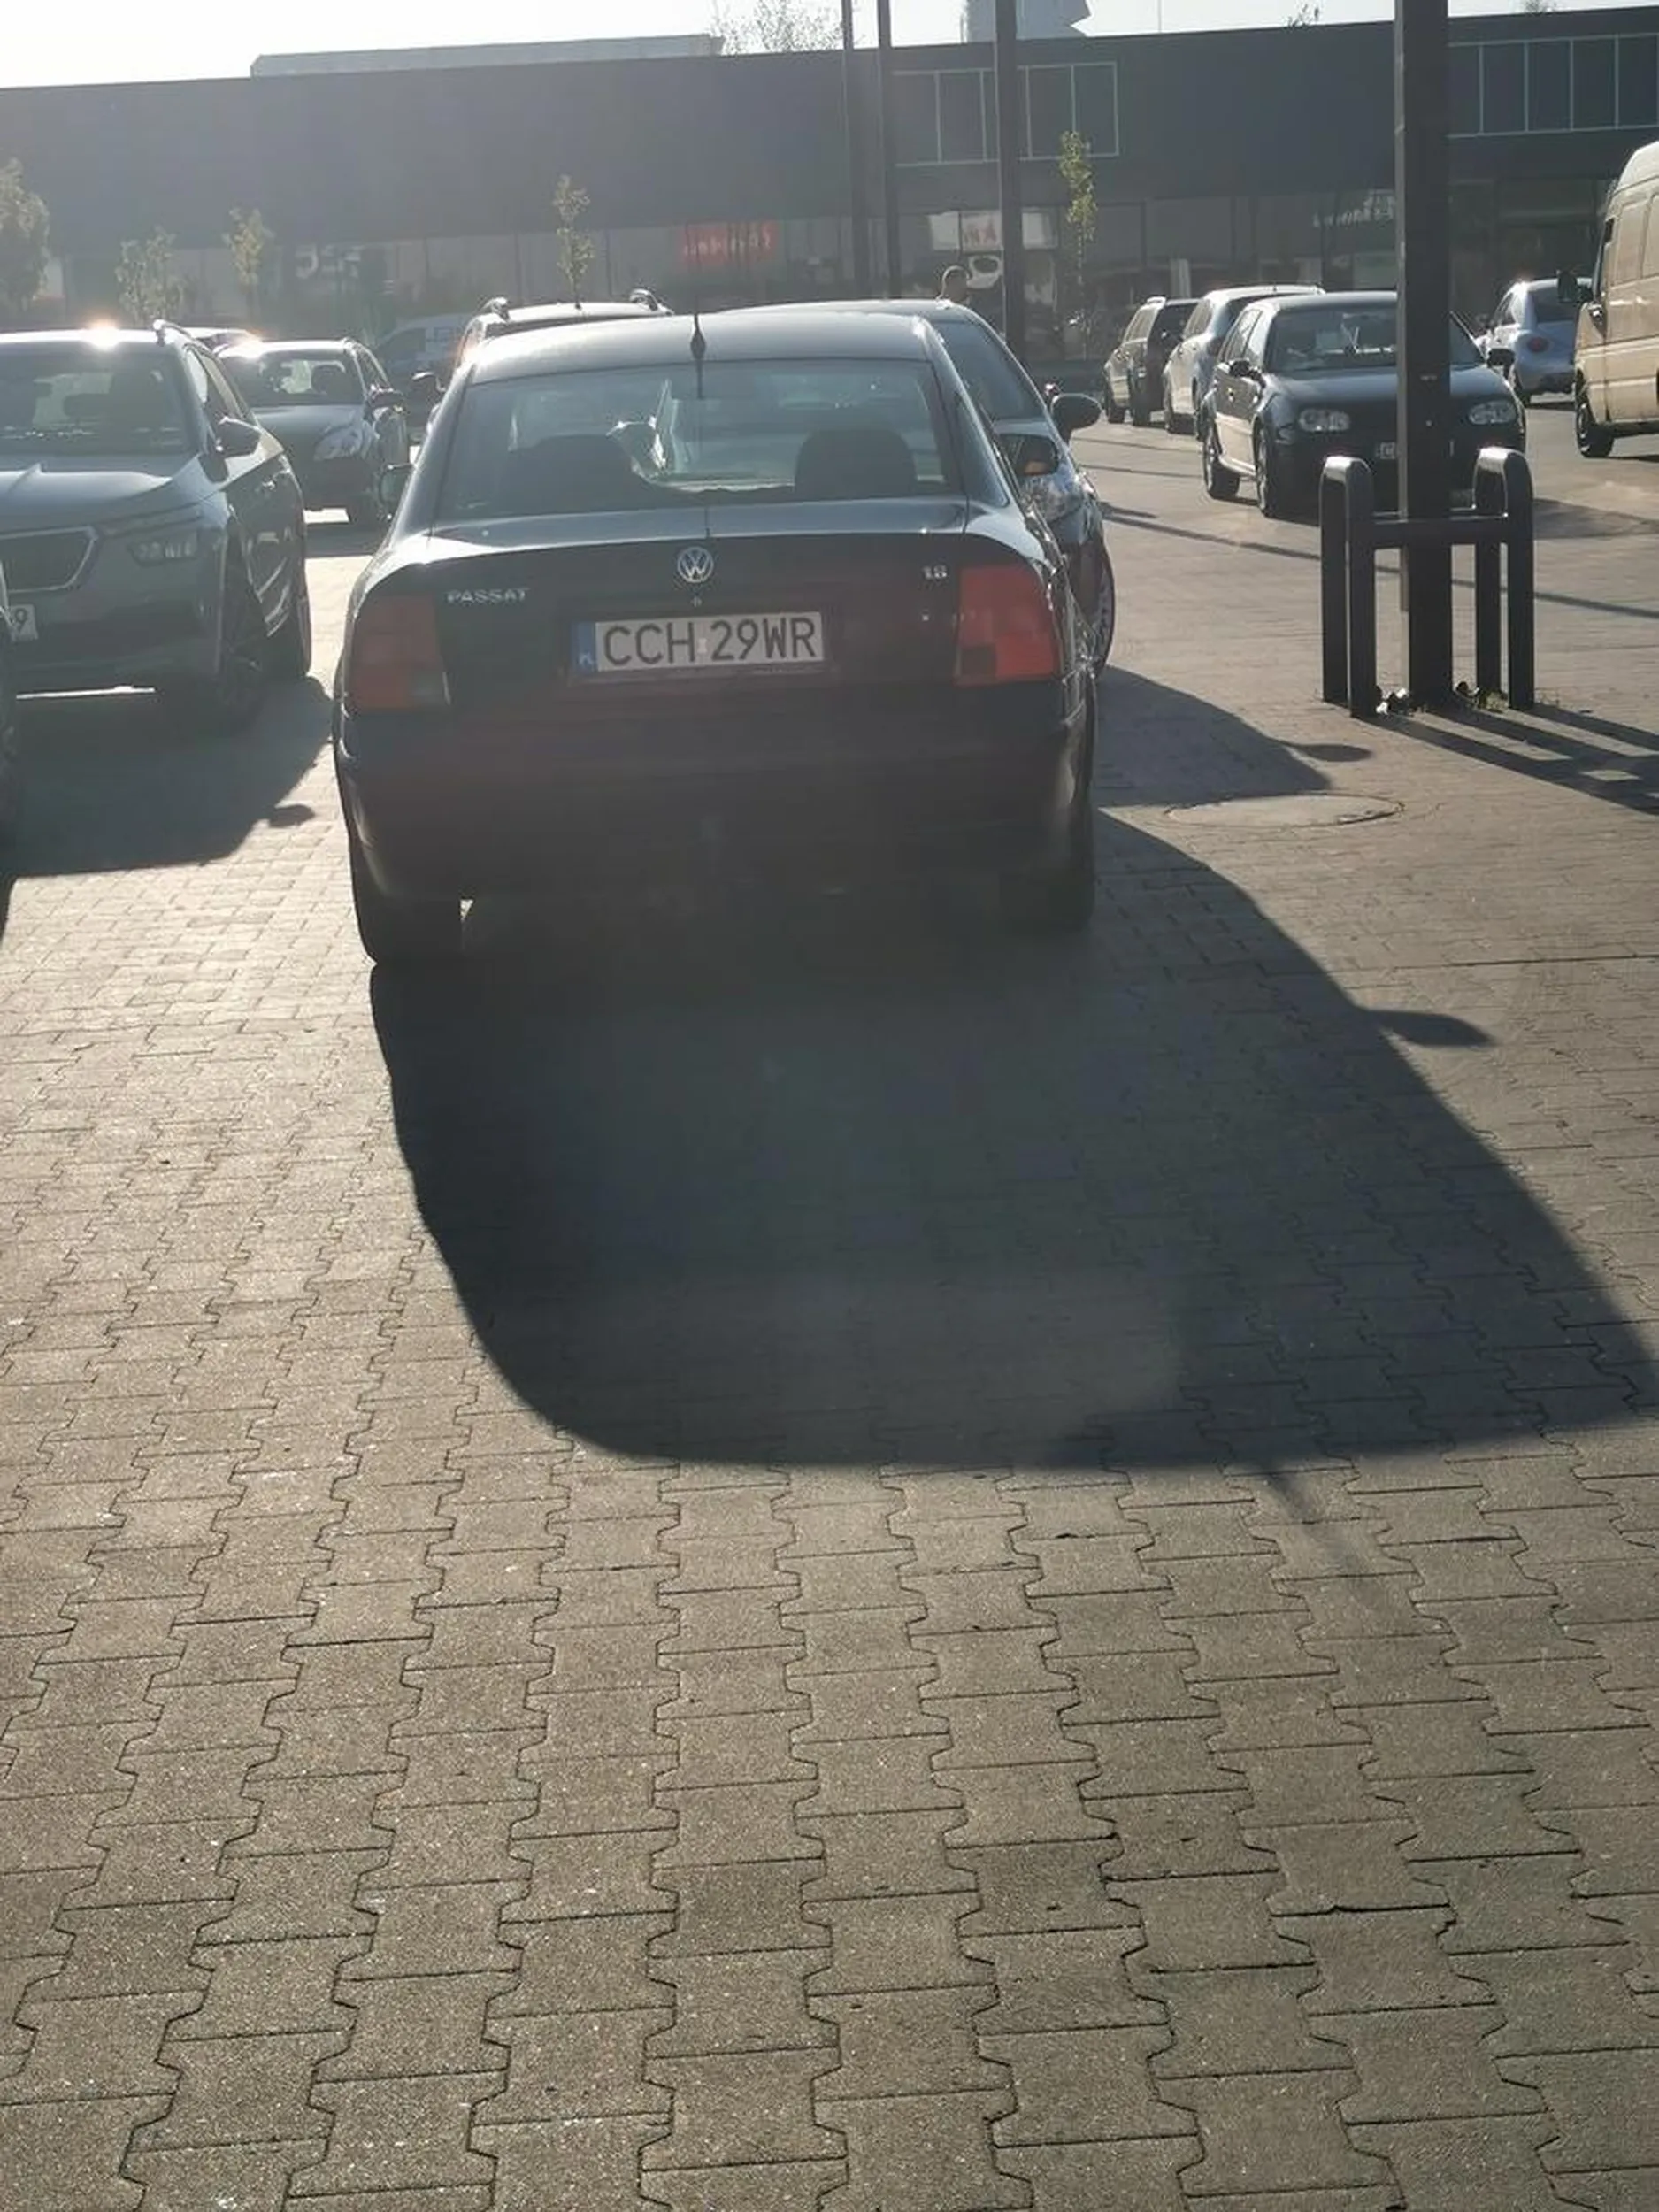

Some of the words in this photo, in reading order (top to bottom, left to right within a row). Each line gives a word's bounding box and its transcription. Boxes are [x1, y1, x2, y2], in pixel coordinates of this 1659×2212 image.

[444, 588, 530, 603] PASSAT
[603, 621, 696, 665] CCH
[710, 618, 816, 662] 29WR
